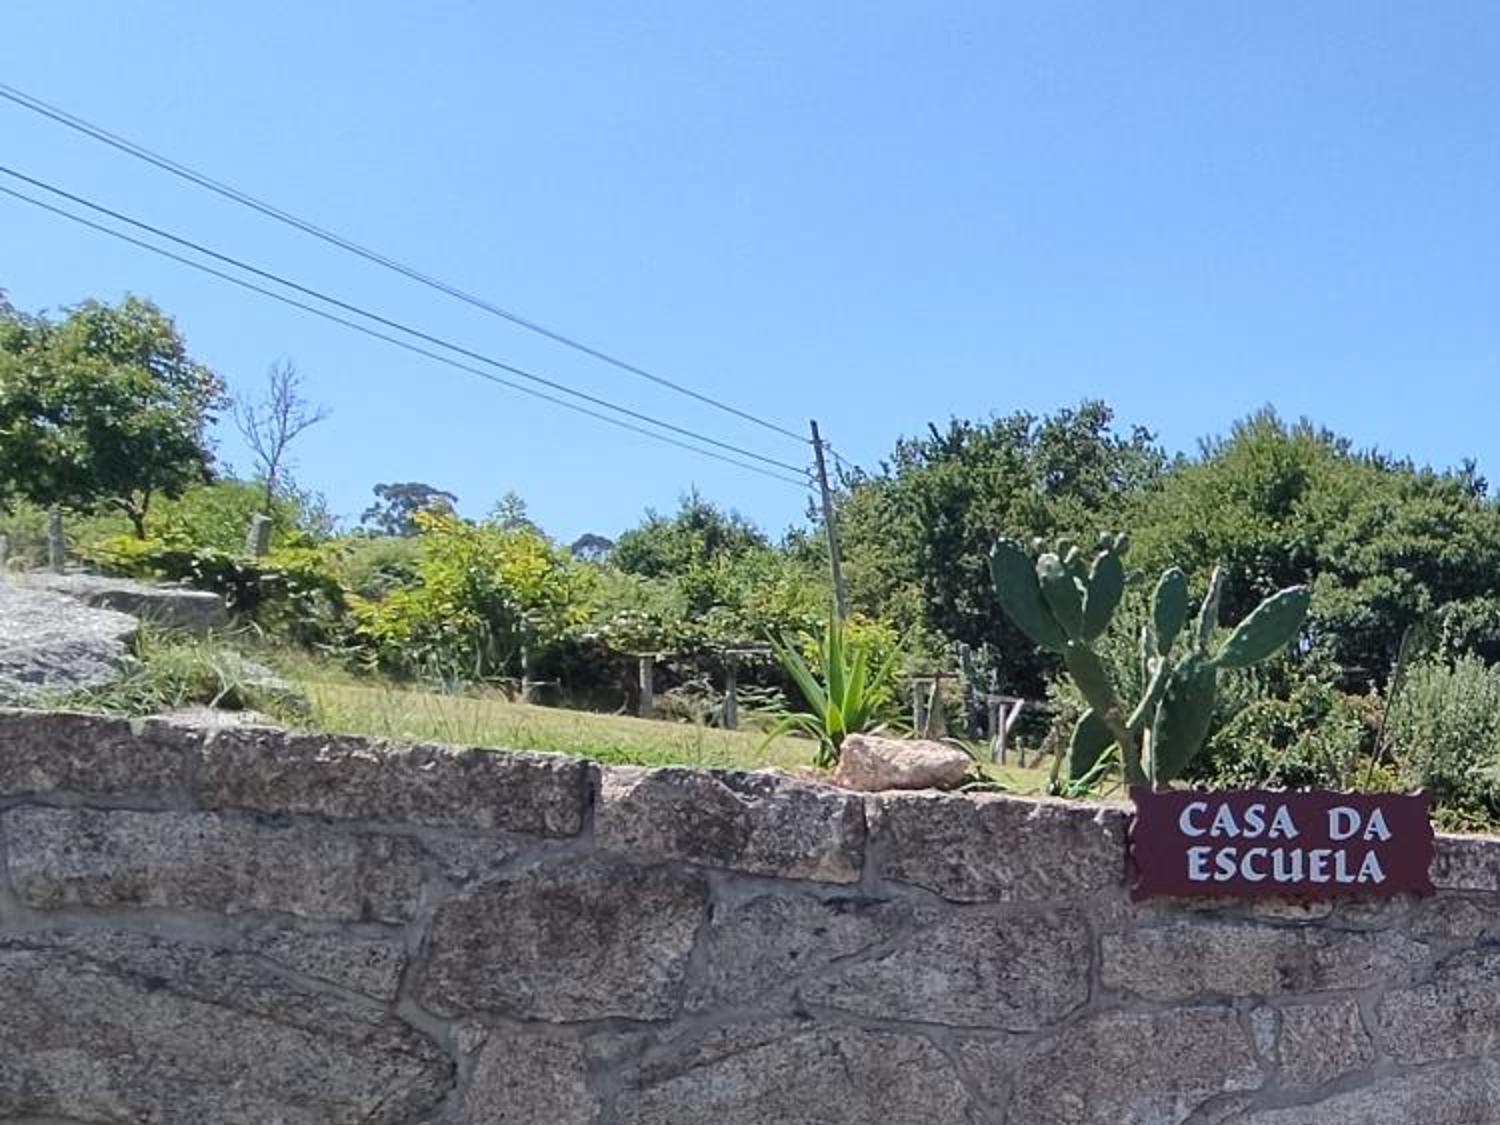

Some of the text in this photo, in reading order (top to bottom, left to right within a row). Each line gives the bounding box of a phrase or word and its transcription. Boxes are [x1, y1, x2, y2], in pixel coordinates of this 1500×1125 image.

[1179, 801, 1392, 841] CASA DA
[1187, 846, 1386, 883] ESCUELA
